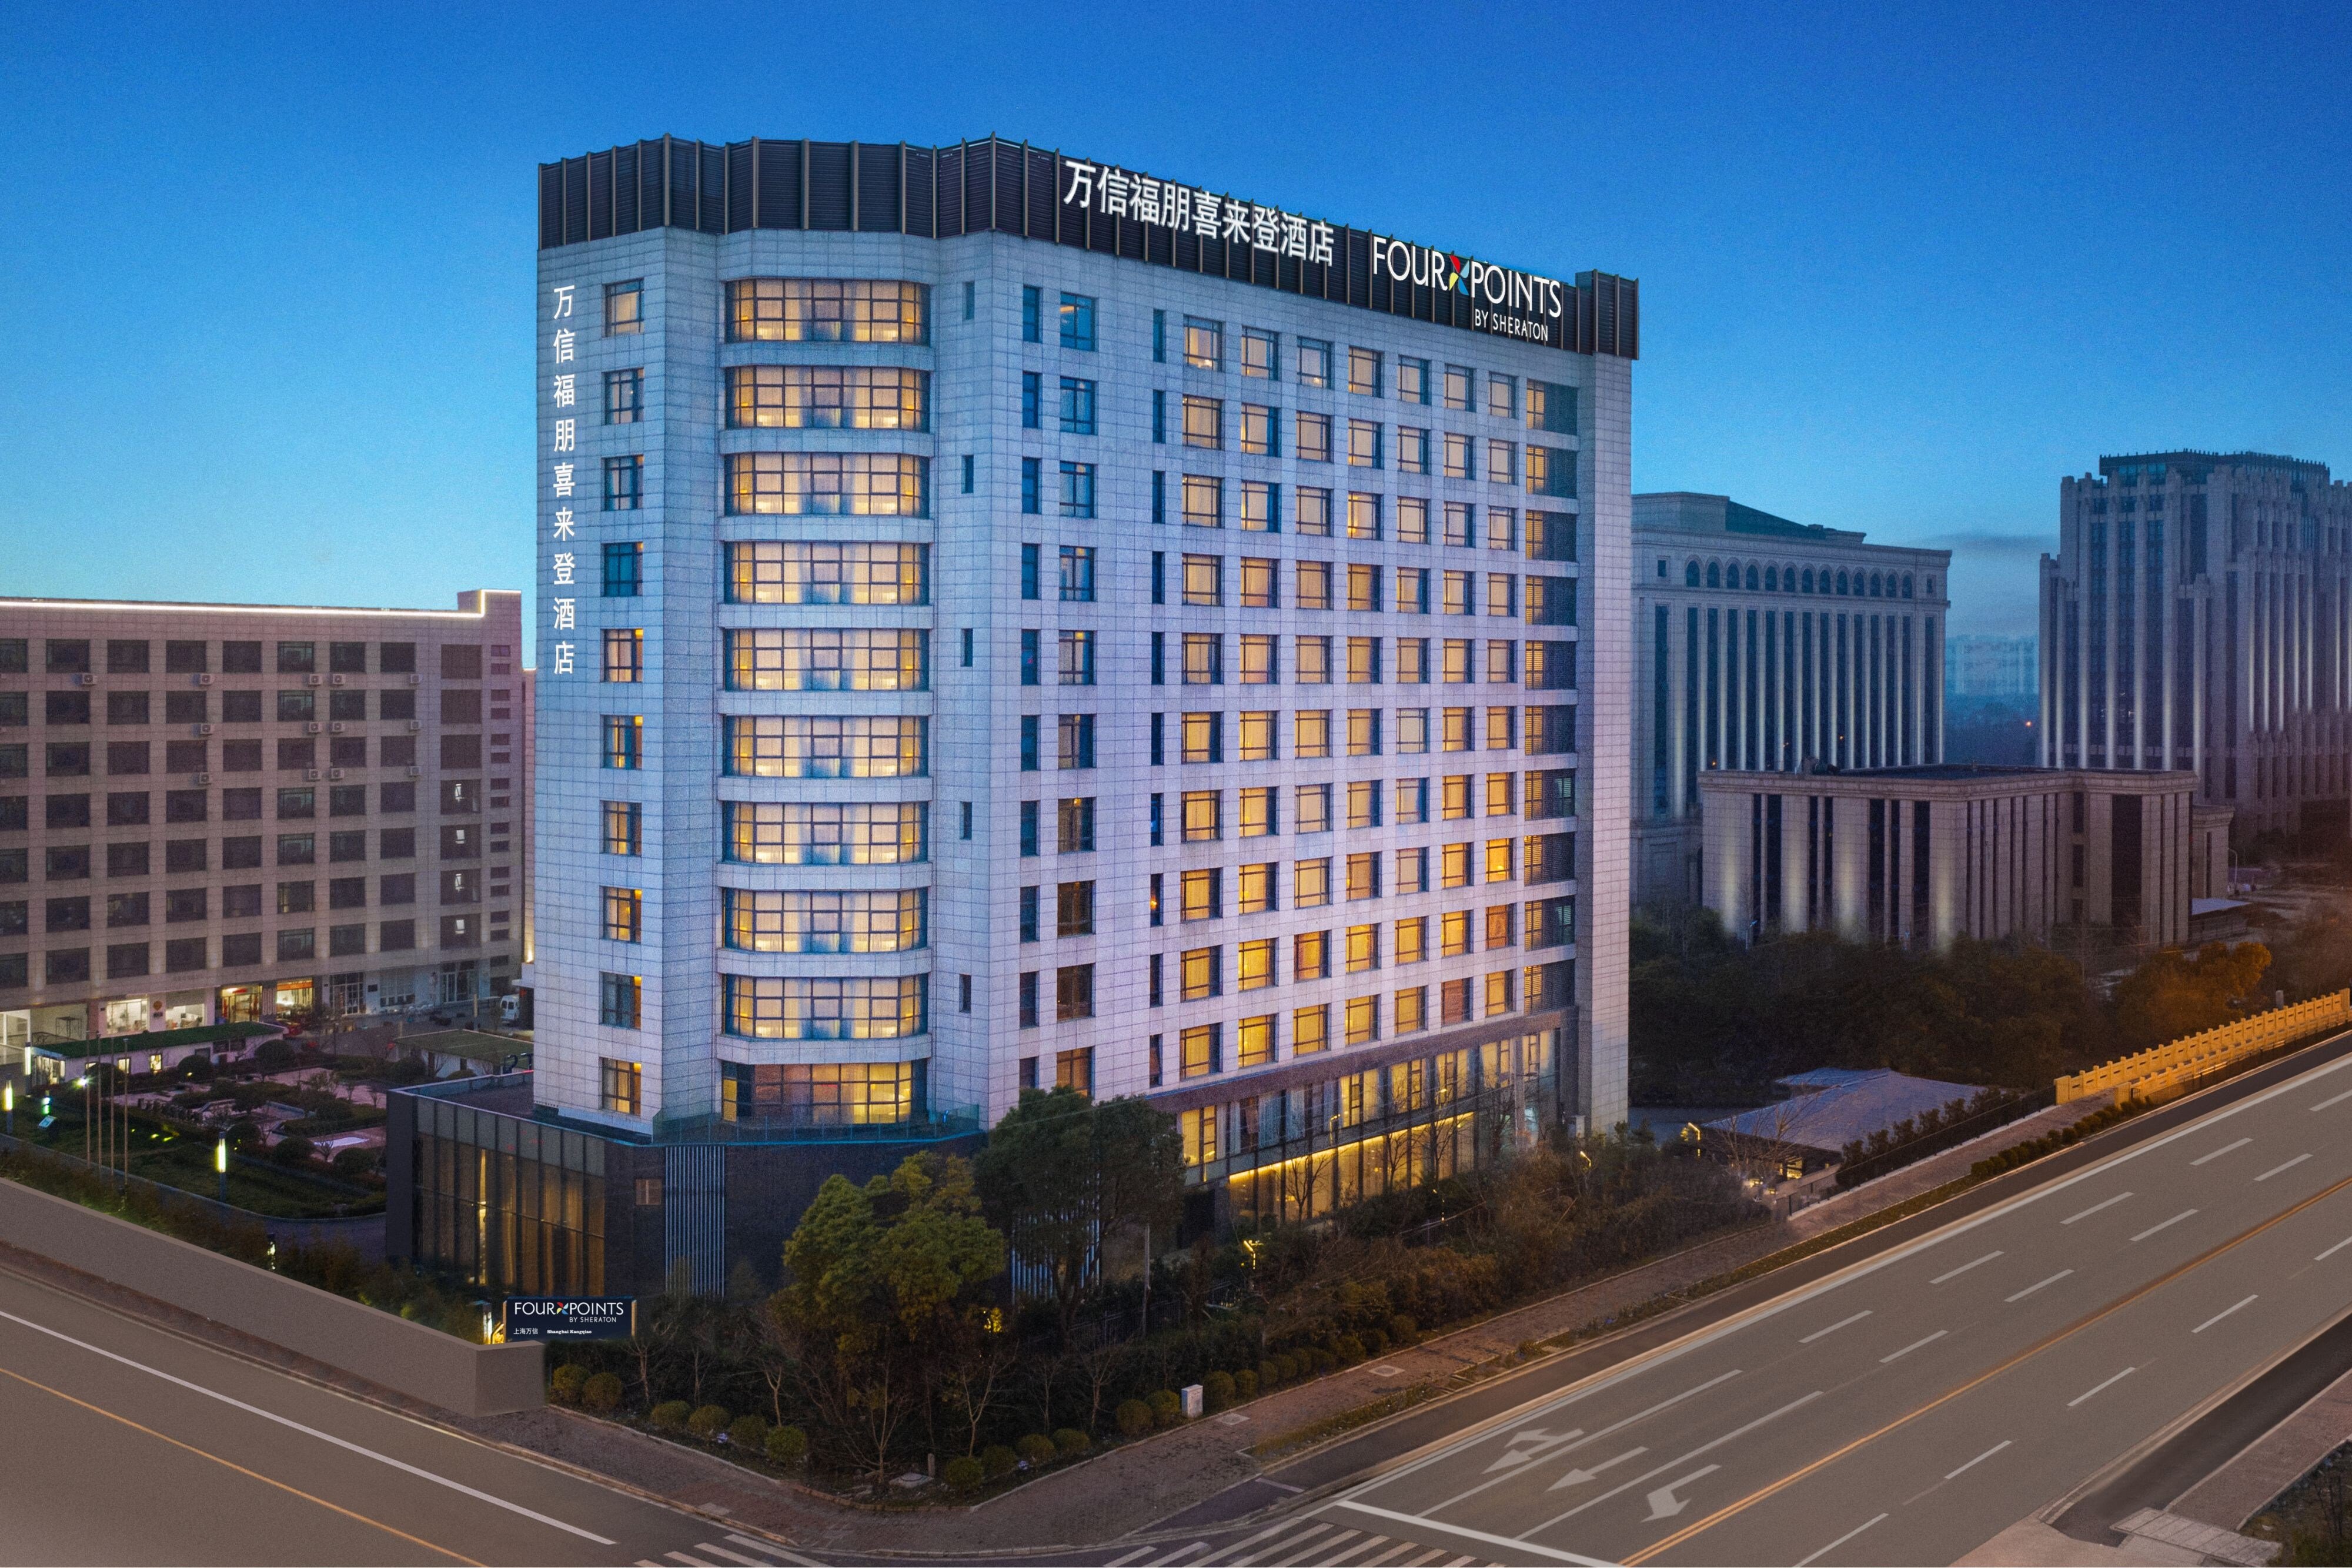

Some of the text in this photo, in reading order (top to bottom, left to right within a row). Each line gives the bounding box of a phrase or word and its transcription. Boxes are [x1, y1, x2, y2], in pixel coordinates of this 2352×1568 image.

[1064, 160, 1334, 267] 万信福朋喜来登酒店
[1374, 236, 1561, 318] FOUR POINTS
[1475, 309, 1548, 342] BY SHERATON
[553, 285, 576, 675] 万信福朋喜来登酒店
[514, 1302, 624, 1315] FOUR POINTS
